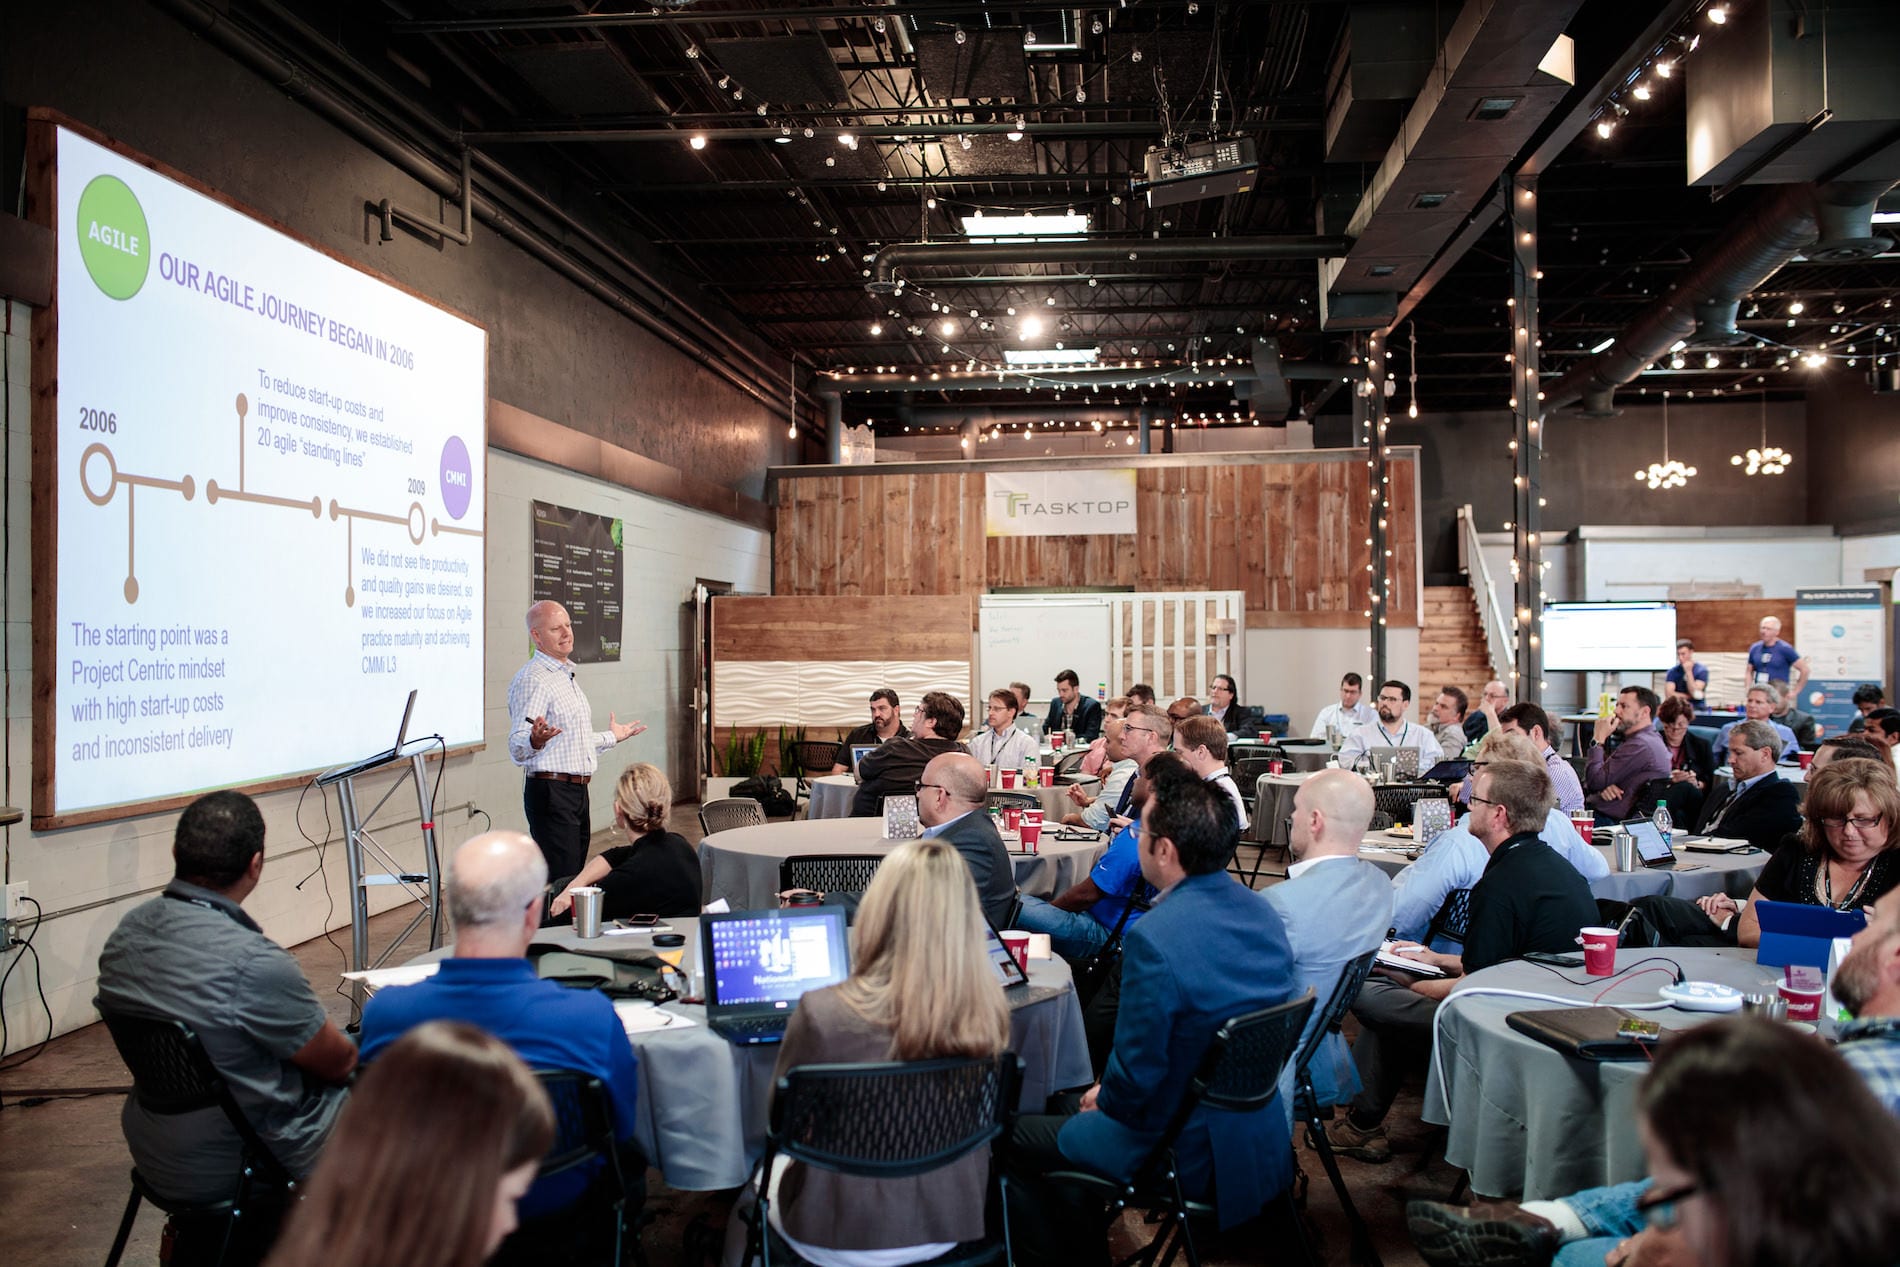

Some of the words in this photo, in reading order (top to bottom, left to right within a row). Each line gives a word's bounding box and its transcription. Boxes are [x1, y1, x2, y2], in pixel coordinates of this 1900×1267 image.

[88, 220, 139, 256] AGILE
[159, 252, 200, 291] OUR
[204, 271, 254, 311] AGILE
[258, 292, 326, 337] JOURNEY
[329, 320, 373, 356] BEGAN
[376, 338, 387, 361] IN
[390, 344, 414, 370] 2006
[258, 368, 271, 389] To
[273, 377, 306, 400] reduce
[308, 387, 342, 414] start-up
[344, 399, 367, 417] costs
[369, 407, 383, 422] and
[80, 406, 117, 434] 2006
[258, 397, 297, 424] improve
[300, 413, 354, 443] consistency,
[356, 428, 368, 443] we
[370, 432, 413, 454] established
[258, 426, 271, 447] 20
[274, 433, 297, 455] agile
[408, 477, 426, 496] 2009
[446, 469, 467, 487] CMMI
[1019, 501, 1129, 515] TASKTOP
[361, 547, 375, 565] We
[377, 549, 389, 567] did
[391, 551, 403, 568] not
[405, 556, 418, 569] see
[420, 554, 431, 570] the
[432, 556, 469, 578] productivity
[361, 576, 377, 592] and
[378, 577, 404, 598] quality
[405, 580, 424, 598] gains
[426, 583, 437, 596] we
[465, 585, 473, 598] so
[361, 605, 374, 618] we
[375, 603, 412, 620] increased
[413, 606, 425, 620] our
[426, 604, 445, 620] focus
[447, 607, 455, 621] on
[456, 604, 472, 624] Agile
[71, 622, 101, 647] The
[105, 623, 156, 651] starting
[160, 623, 191, 651] point
[194, 629, 218, 645] was
[221, 629, 229, 645] a
[361, 632, 393, 650] practice
[394, 631, 423, 650] maturity
[425, 630, 438, 645] and
[439, 628, 470, 648] achieving
[72, 659, 124, 689] Project
[128, 657, 175, 681] Centric
[178, 656, 225, 679] mindset
[387, 656, 397, 673] L3
[71, 697, 101, 722] with
[107, 695, 136, 724] high
[140, 694, 189, 719] start-up
[193, 691, 224, 713] costs
[72, 735, 100, 761] and
[105, 729, 184, 758] inconsistent
[188, 725, 233, 750] delivery
